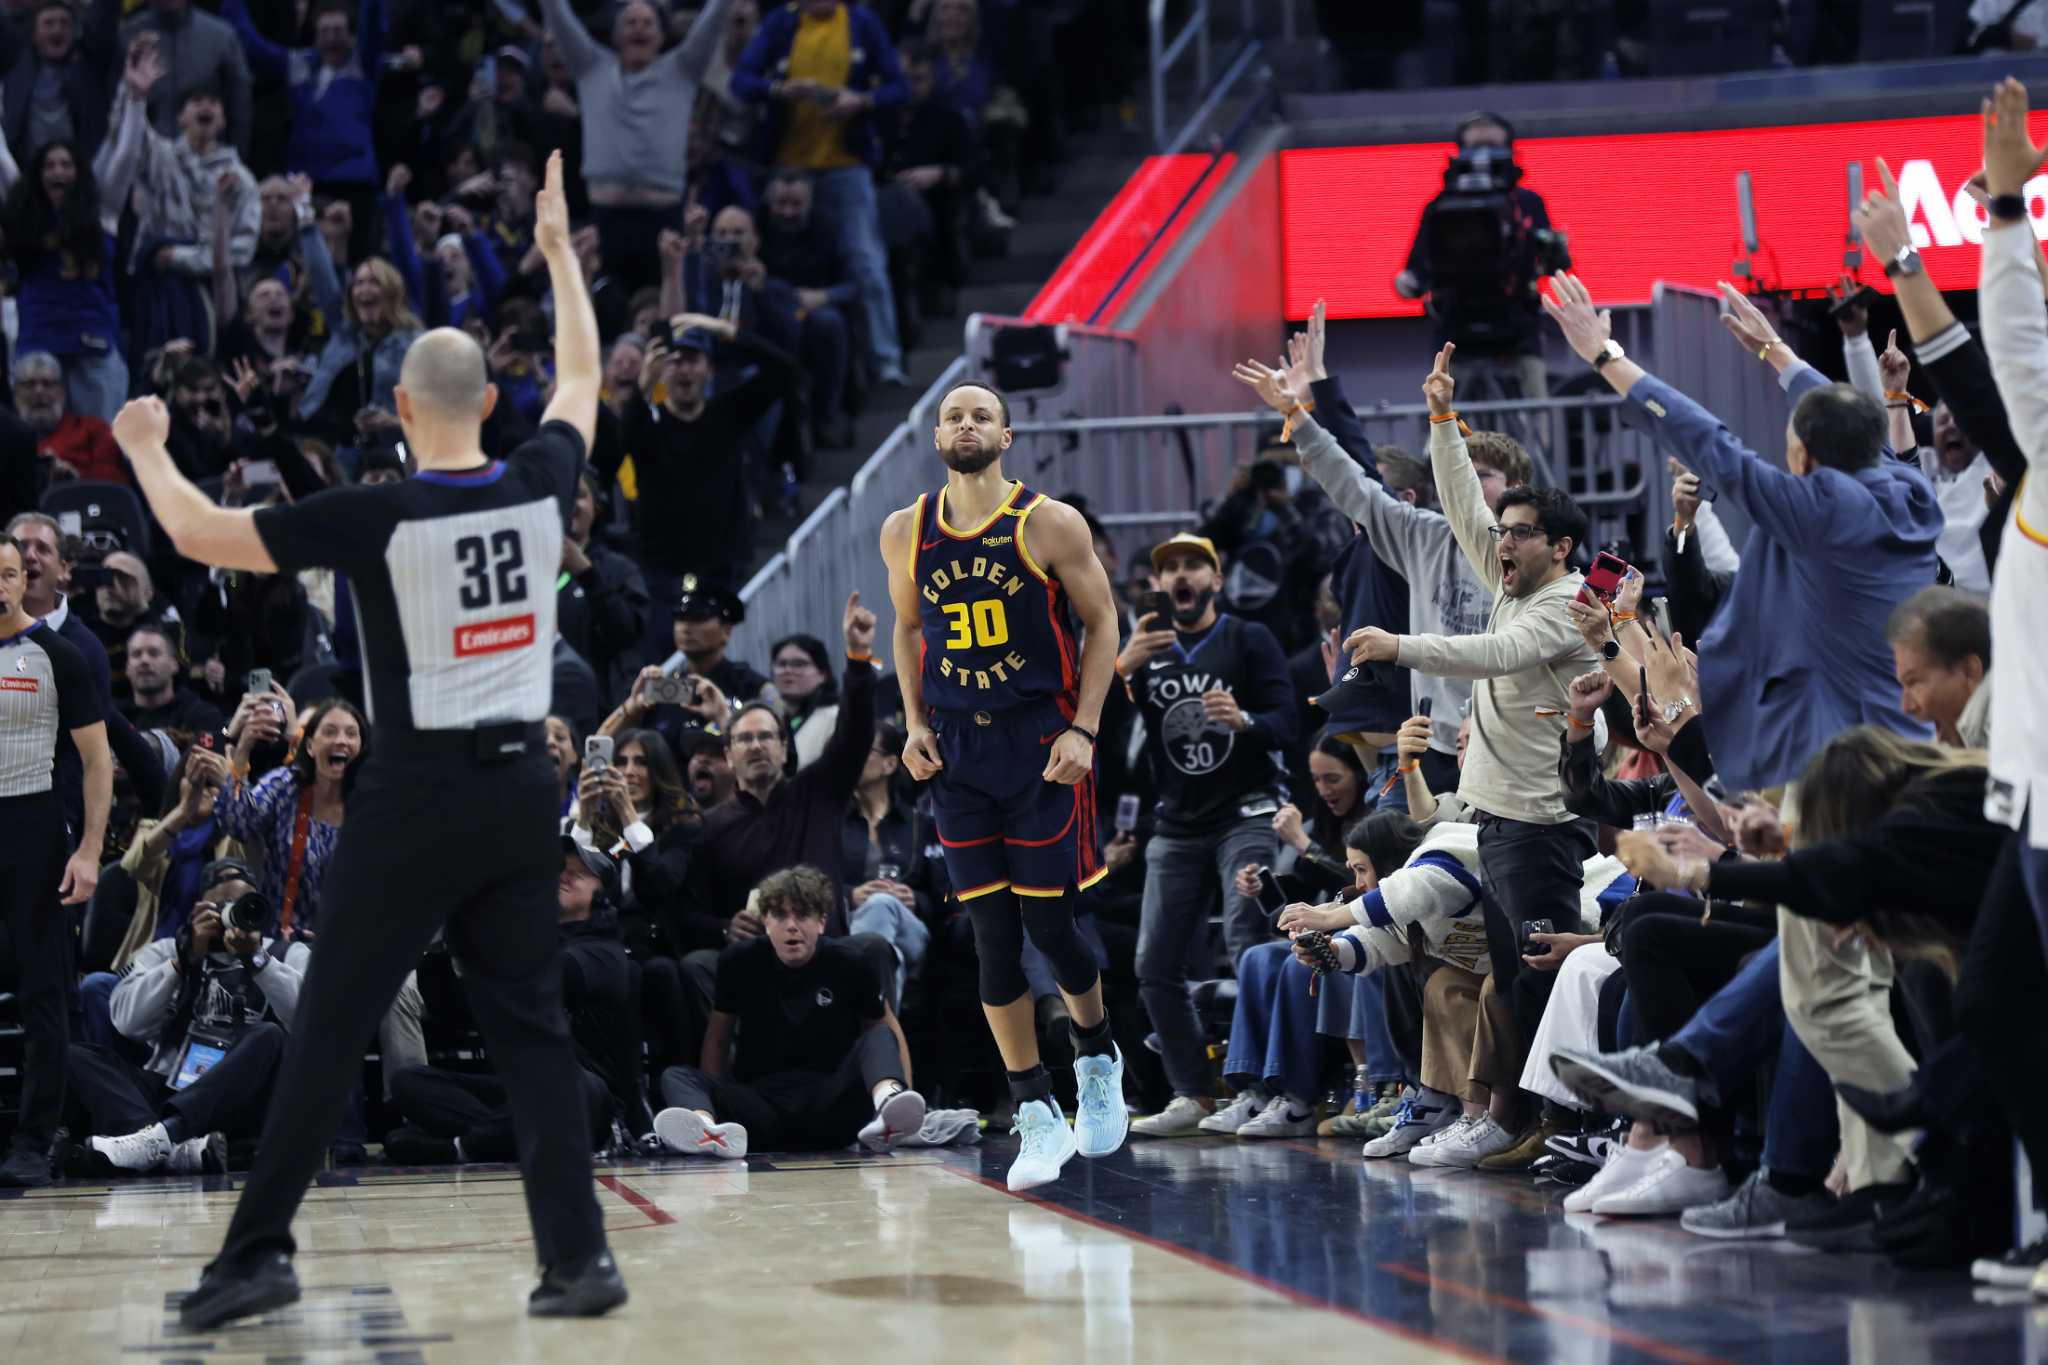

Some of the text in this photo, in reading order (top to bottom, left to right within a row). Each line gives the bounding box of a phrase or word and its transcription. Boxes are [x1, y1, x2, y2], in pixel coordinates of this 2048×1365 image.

[982, 535, 1013, 546] Rakuten
[455, 529, 527, 610] 32
[923, 556, 1024, 604] GOLDEN
[460, 622, 531, 651] Emirates
[941, 599, 1009, 650] 30
[940, 650, 1027, 689] STATE
[1183, 742, 1214, 769] 30
